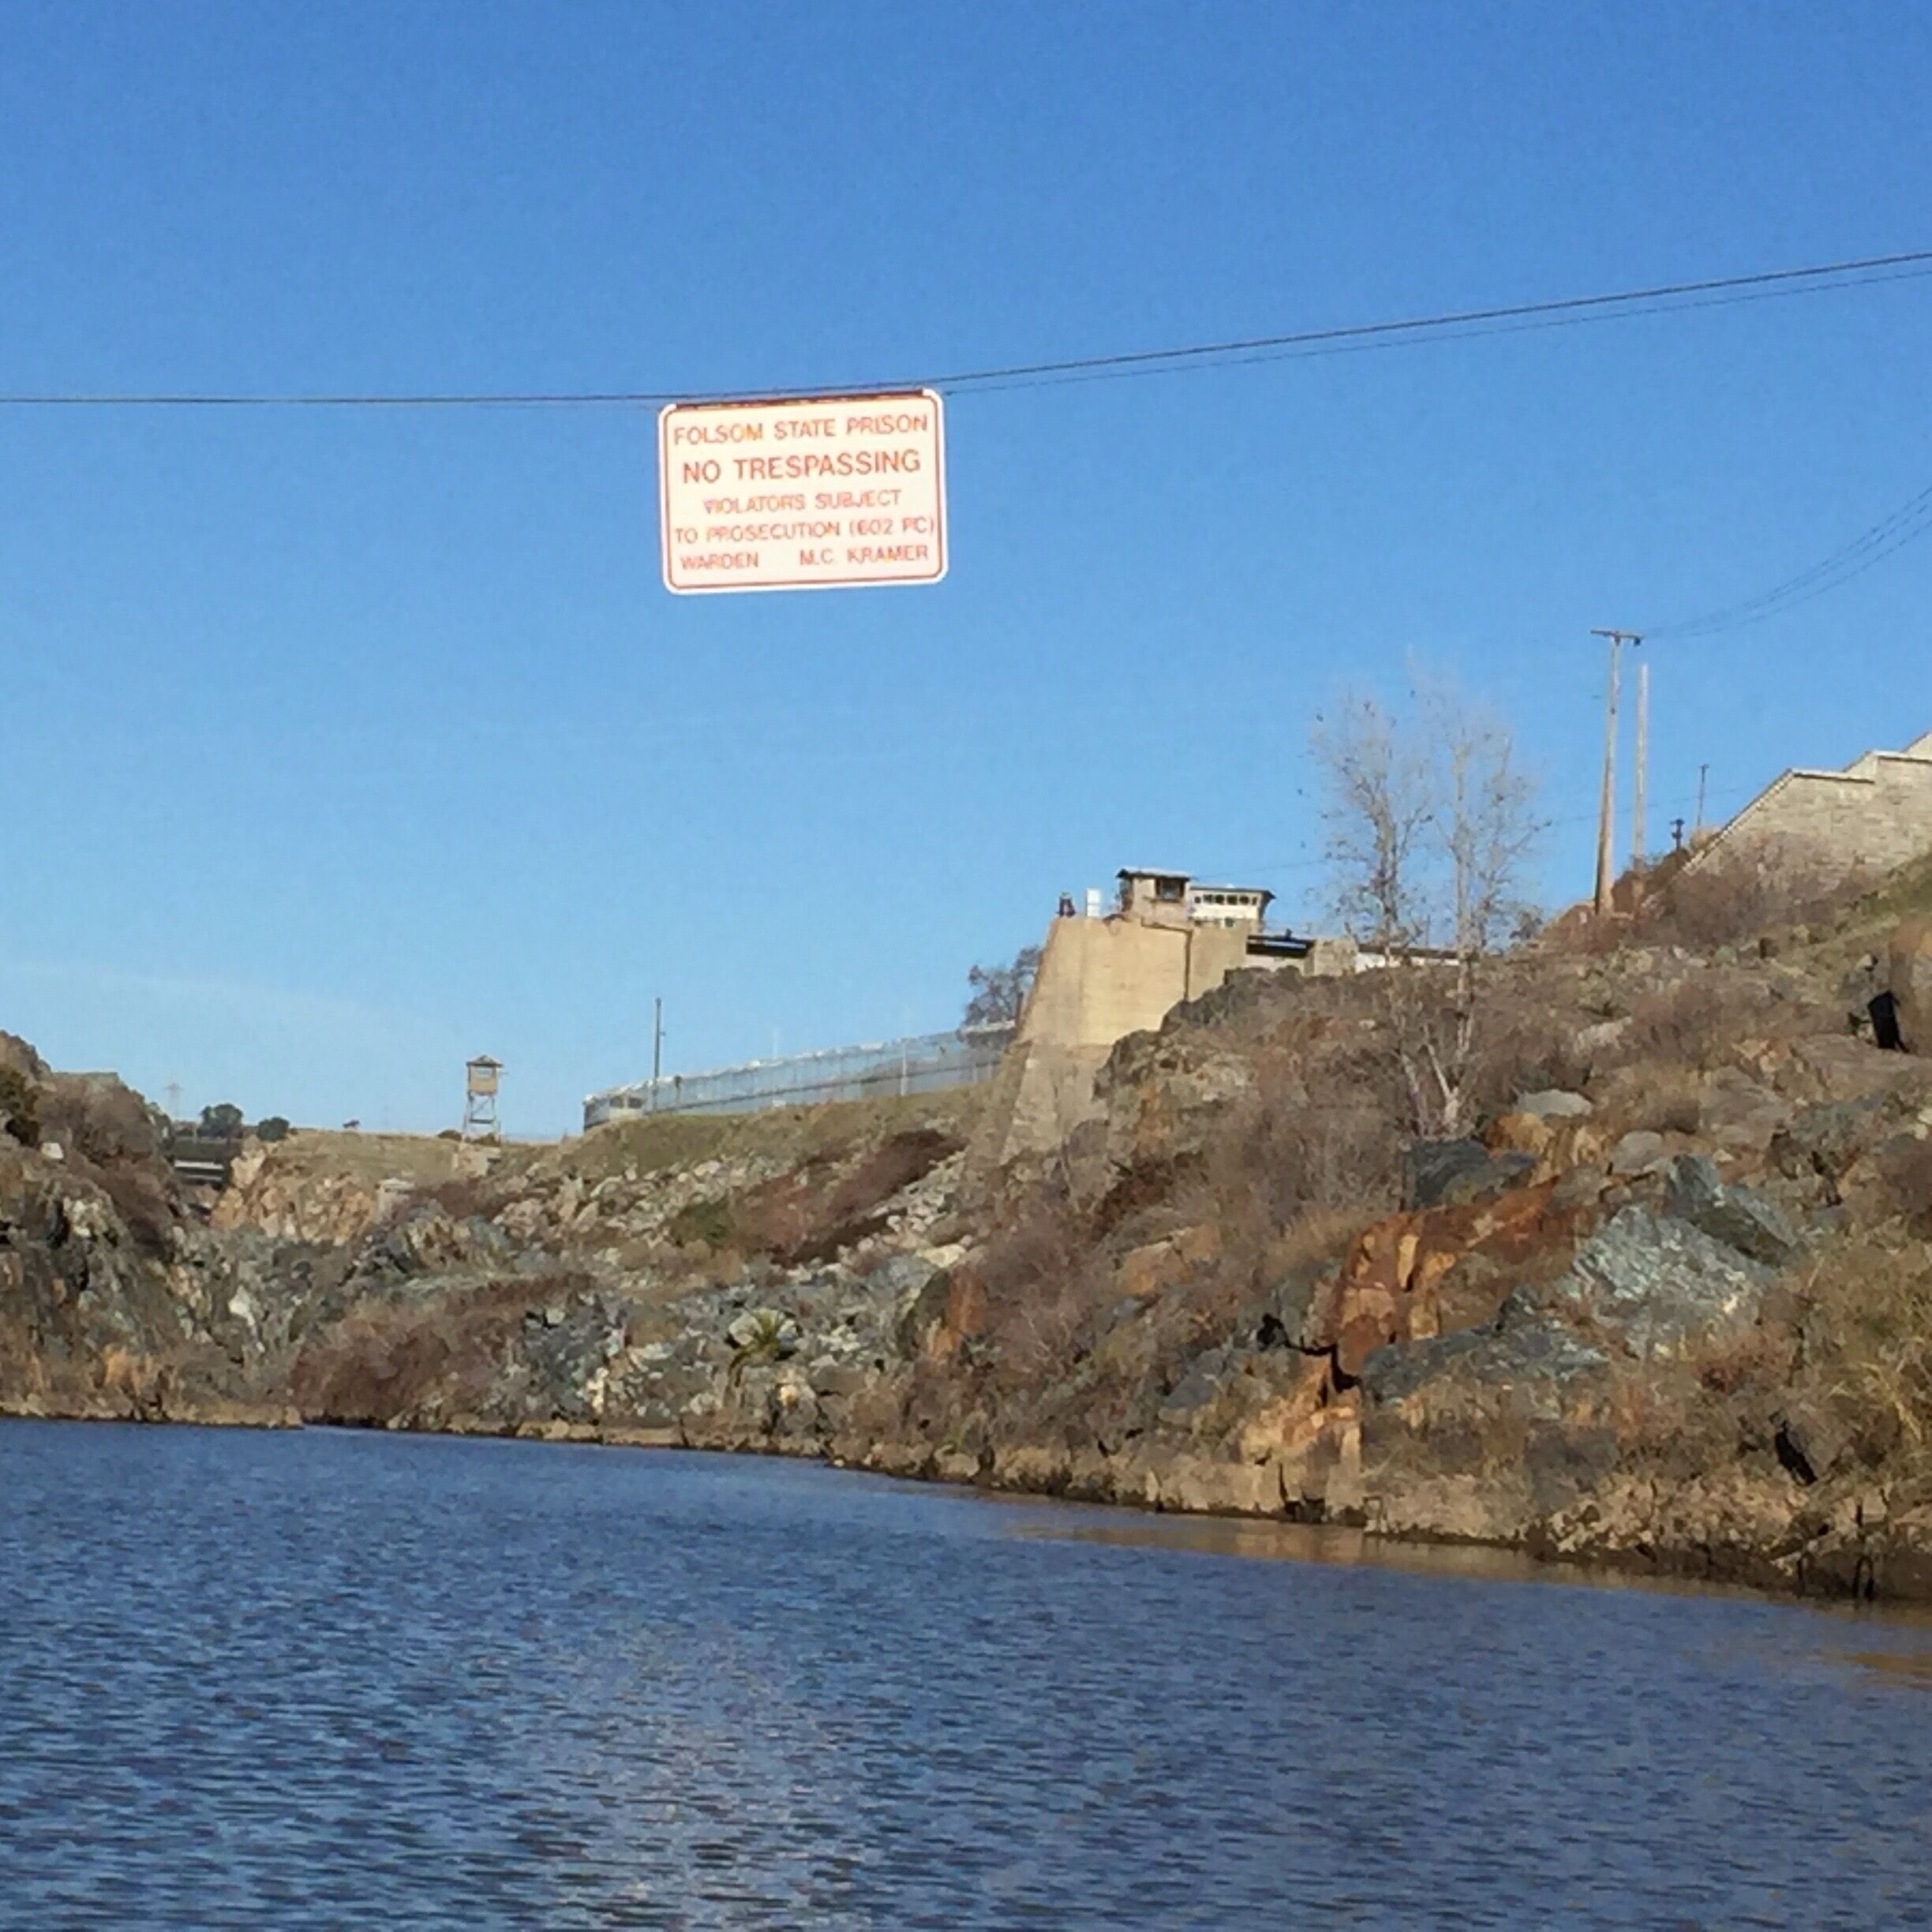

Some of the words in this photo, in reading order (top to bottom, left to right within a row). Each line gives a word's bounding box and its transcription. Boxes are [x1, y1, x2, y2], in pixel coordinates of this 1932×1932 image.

[673, 423, 763, 445] FOLSOM
[773, 418, 837, 440] STATE
[846, 414, 928, 435] PRISON
[683, 460, 721, 484] NO
[734, 449, 921, 481] TRESPASSING
[703, 494, 806, 514] VIOLATORS
[815, 489, 902, 510] SUBJECT
[676, 528, 698, 544] TO
[706, 521, 841, 542] PROSECUTION
[849, 518, 894, 537] (602
[902, 516, 935, 535] PC)
[680, 552, 759, 571] WARDEN
[847, 545, 929, 564] KRAMER
